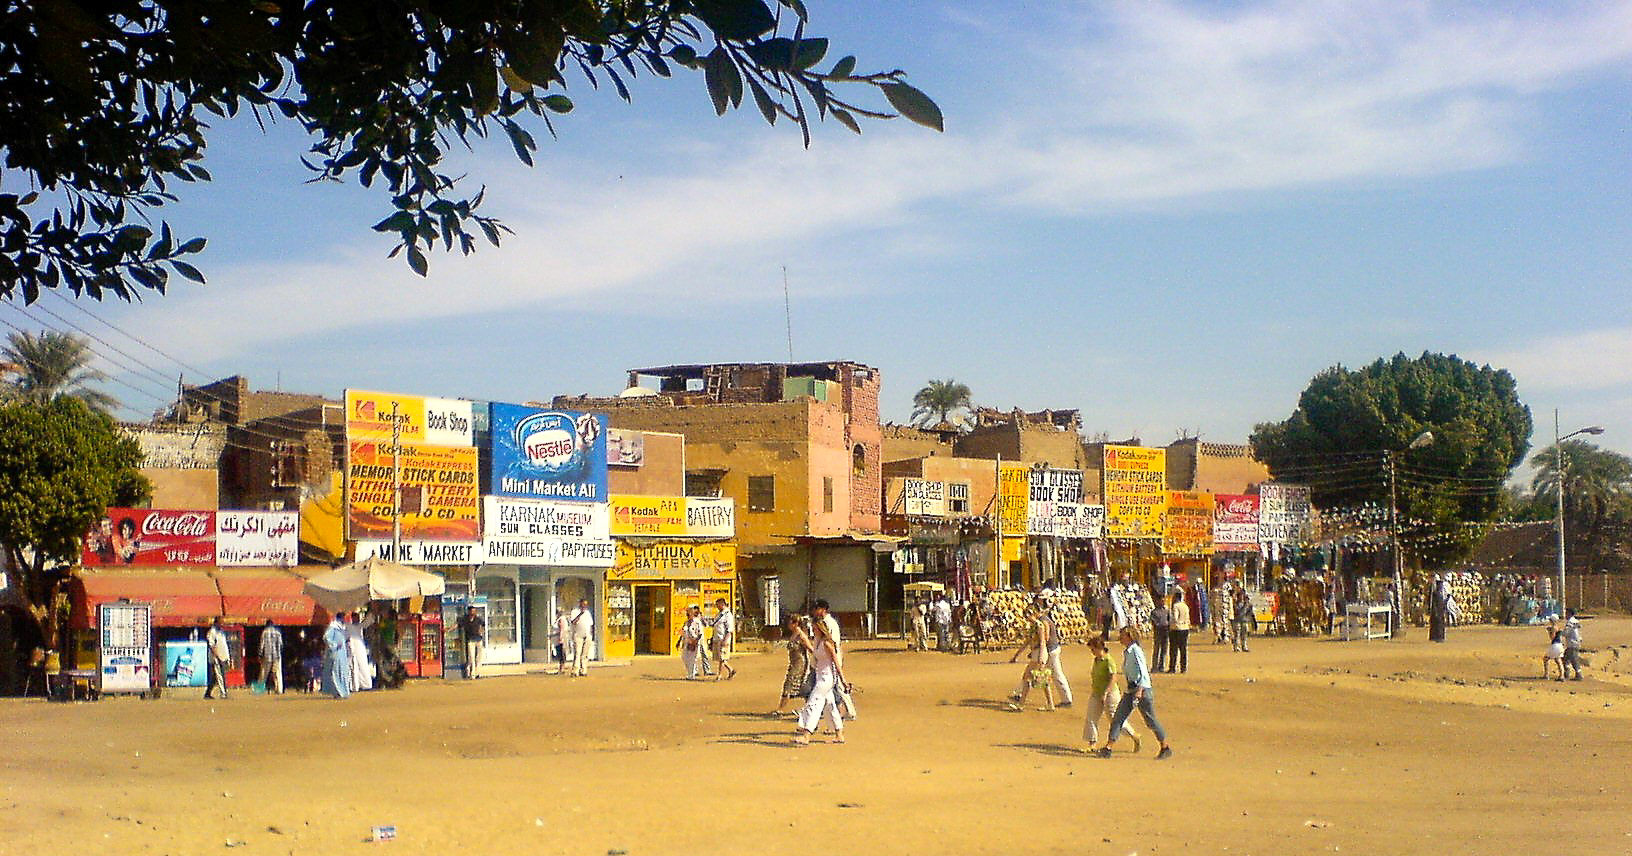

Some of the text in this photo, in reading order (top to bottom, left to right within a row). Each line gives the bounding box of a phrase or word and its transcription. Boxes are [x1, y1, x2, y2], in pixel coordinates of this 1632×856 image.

[378, 411, 410, 424] Koak
[428, 410, 447, 430] Book
[449, 411, 468, 435] Shop
[402, 468, 436, 482] STICK
[439, 469, 474, 484] CARDS
[502, 478, 596, 498] Mini Market Ali
[1030, 486, 1055, 501] BOOK
[1057, 488, 1082, 503] SHOP
[428, 496, 476, 507] CAMERA
[437, 508, 455, 519] CD
[501, 505, 592, 525] KARNAK MUSEUM
[631, 506, 659, 516] Kodak
[687, 506, 732, 527] BATTERY
[1057, 505, 1078, 518] BOOK
[1083, 506, 1104, 518] SHOP
[501, 523, 584, 537] SUN GLASSES
[423, 545, 472, 561] MARKET
[634, 546, 695, 558] LITHIUM
[634, 558, 700, 569] BATTERY
